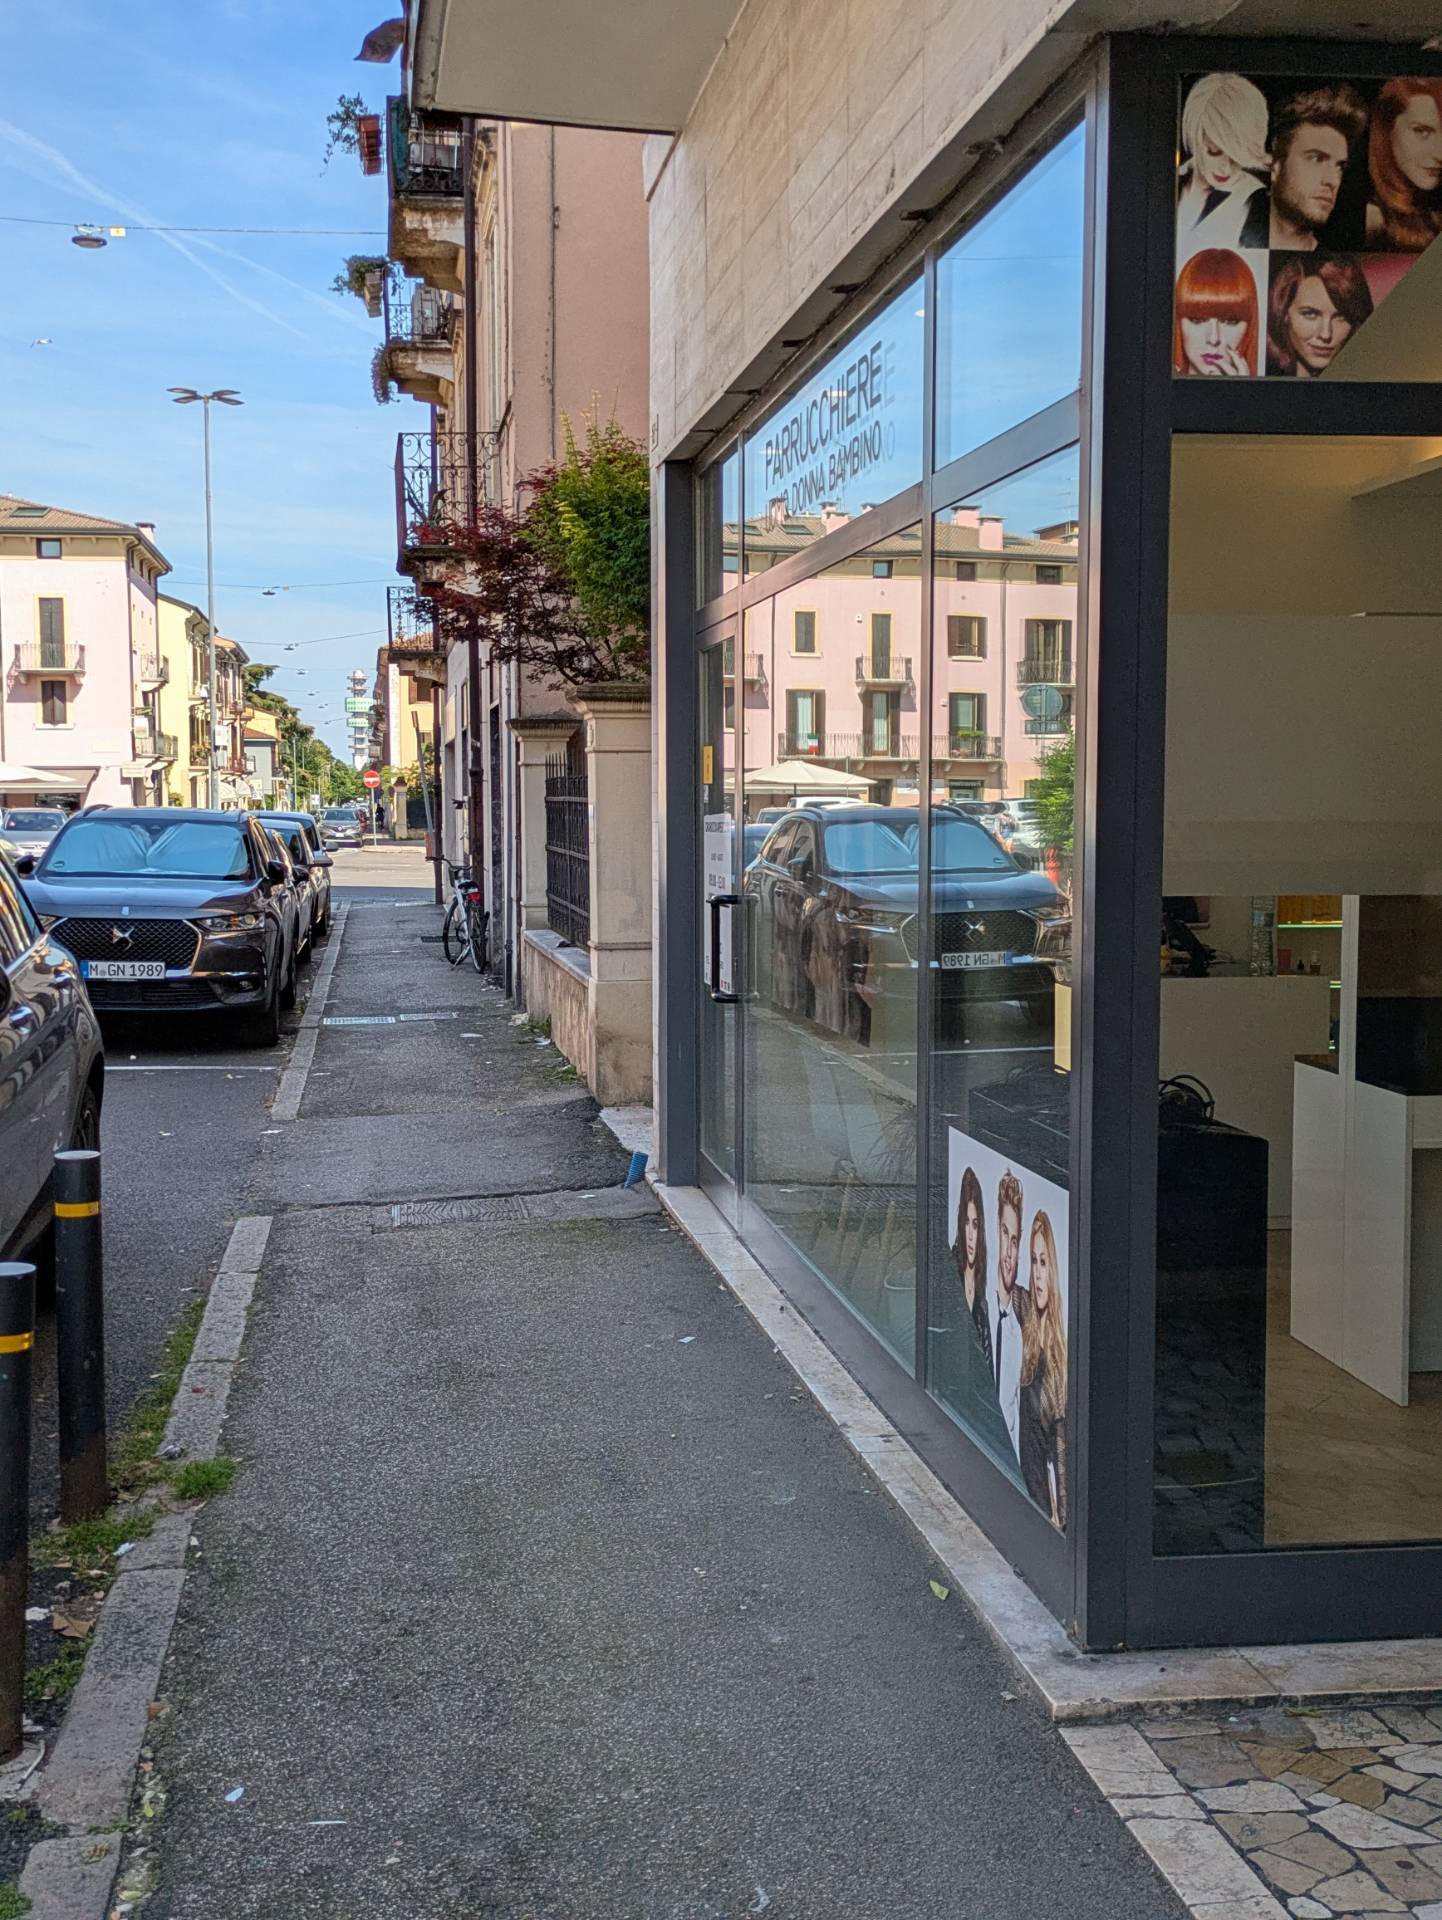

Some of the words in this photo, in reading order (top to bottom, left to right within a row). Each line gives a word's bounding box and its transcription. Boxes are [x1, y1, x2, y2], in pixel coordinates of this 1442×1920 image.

[765, 340, 882, 491] PARRUCCHIERE
[792, 461, 826, 515] DONNA
[828, 420, 882, 492] BAMBINO
[129, 964, 164, 977] 1989
